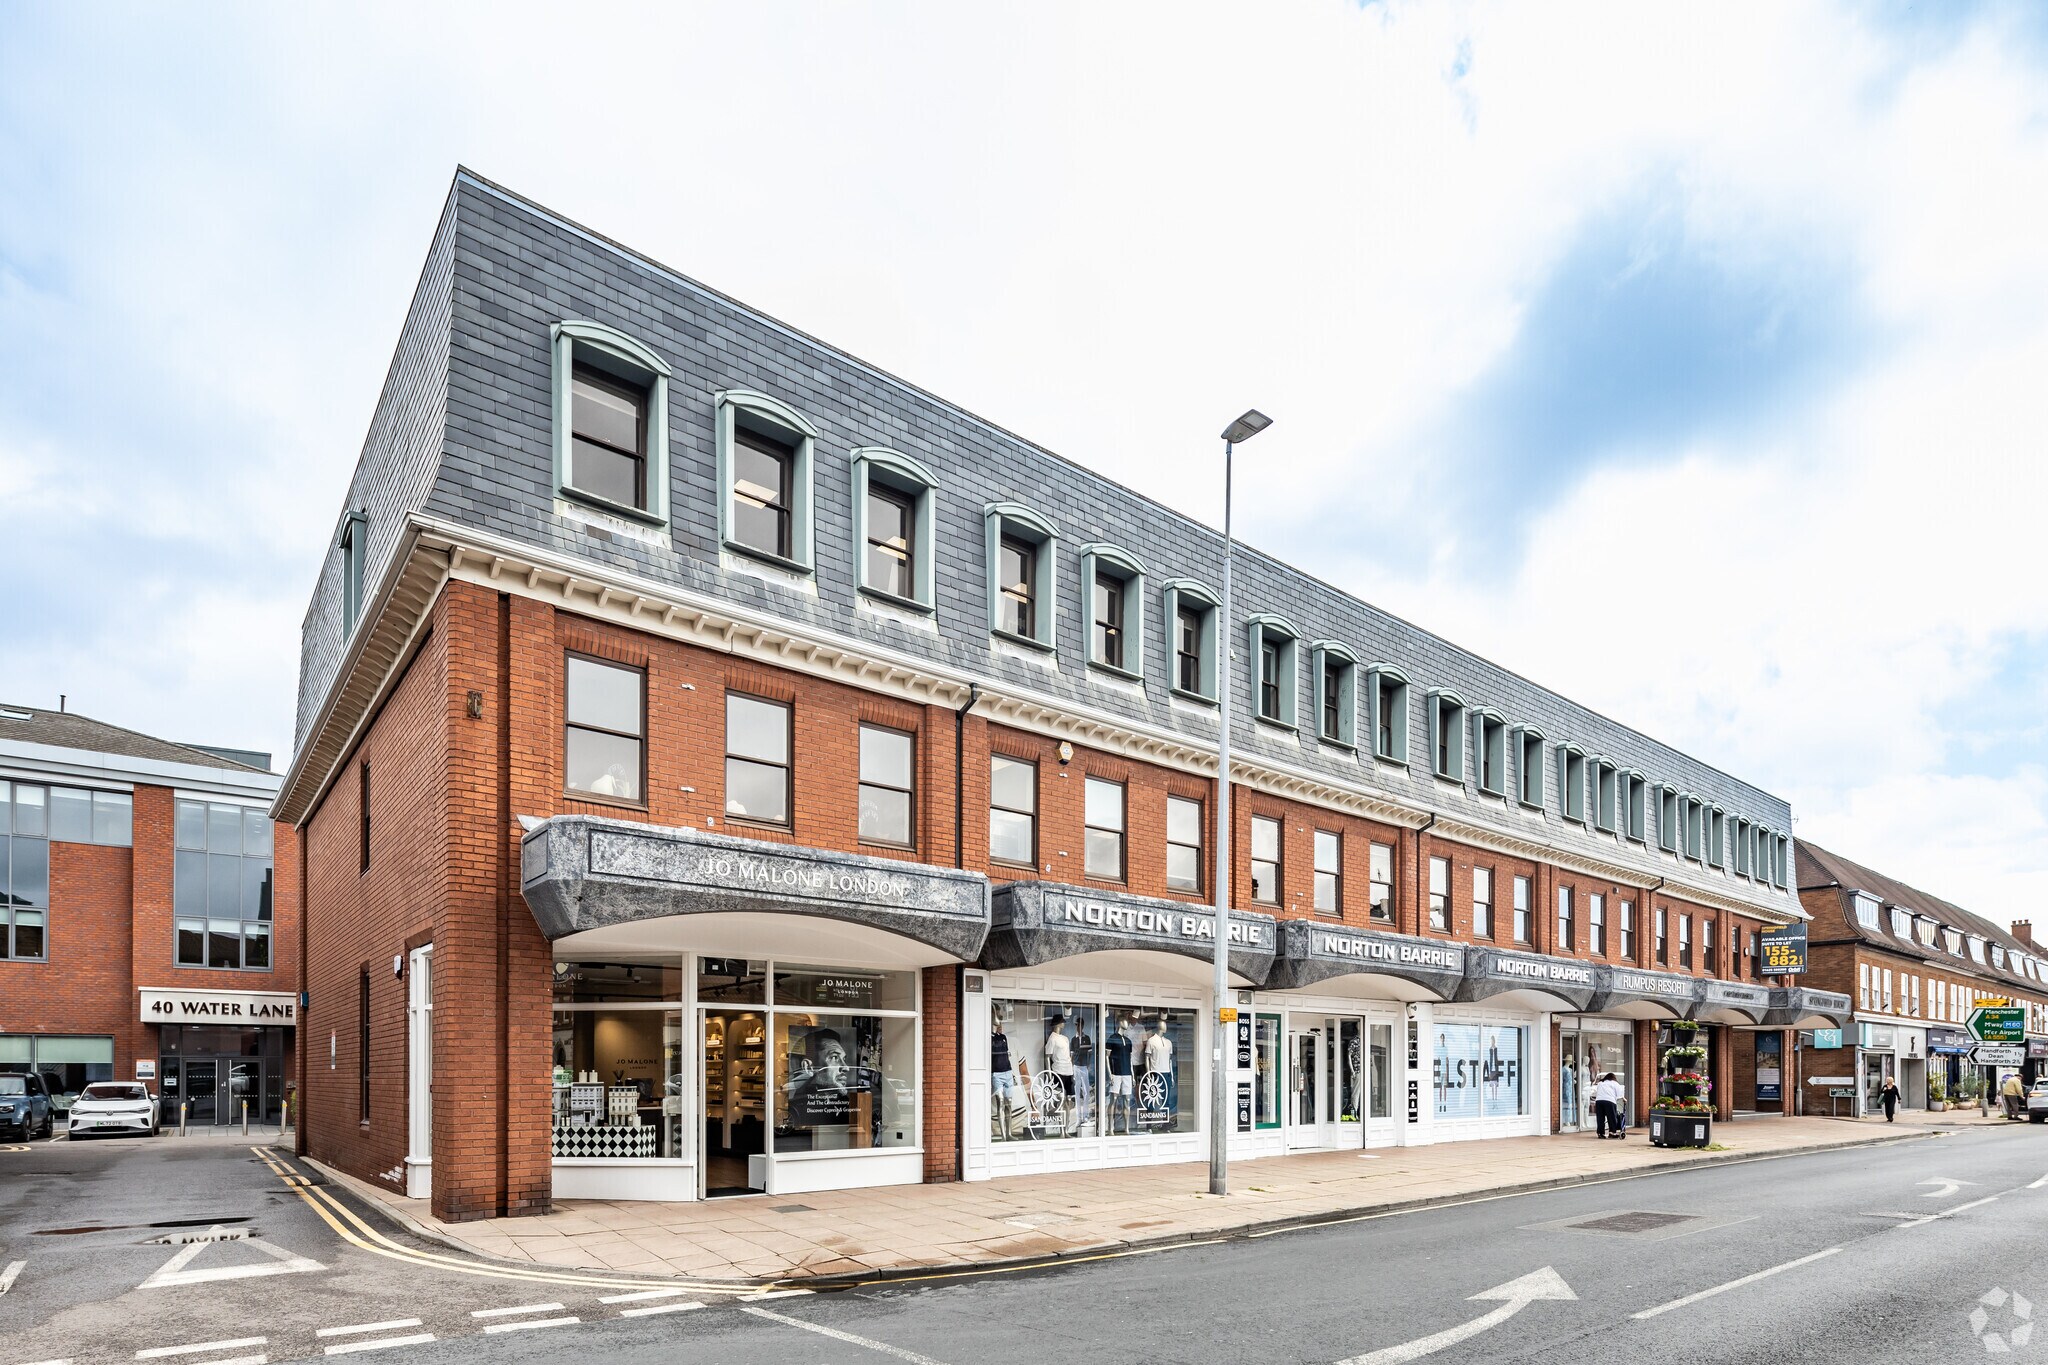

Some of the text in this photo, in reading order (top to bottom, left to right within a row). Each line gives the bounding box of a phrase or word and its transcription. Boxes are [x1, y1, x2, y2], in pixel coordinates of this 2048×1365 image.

[705, 858, 904, 897] JO MALONE LONDON
[1065, 900, 1262, 943] NORTON BARIE
[1324, 937, 1455, 966] NORTON BARRIE
[1764, 946, 1796, 956] 155-
[1769, 955, 1798, 966] 882
[1497, 959, 1590, 982] NORTON BARRIE
[835, 980, 873, 989] MALONE
[1623, 975, 1686, 994] RUMPUS RESORT
[152, 1001, 293, 1018] 40 WATER LANE
